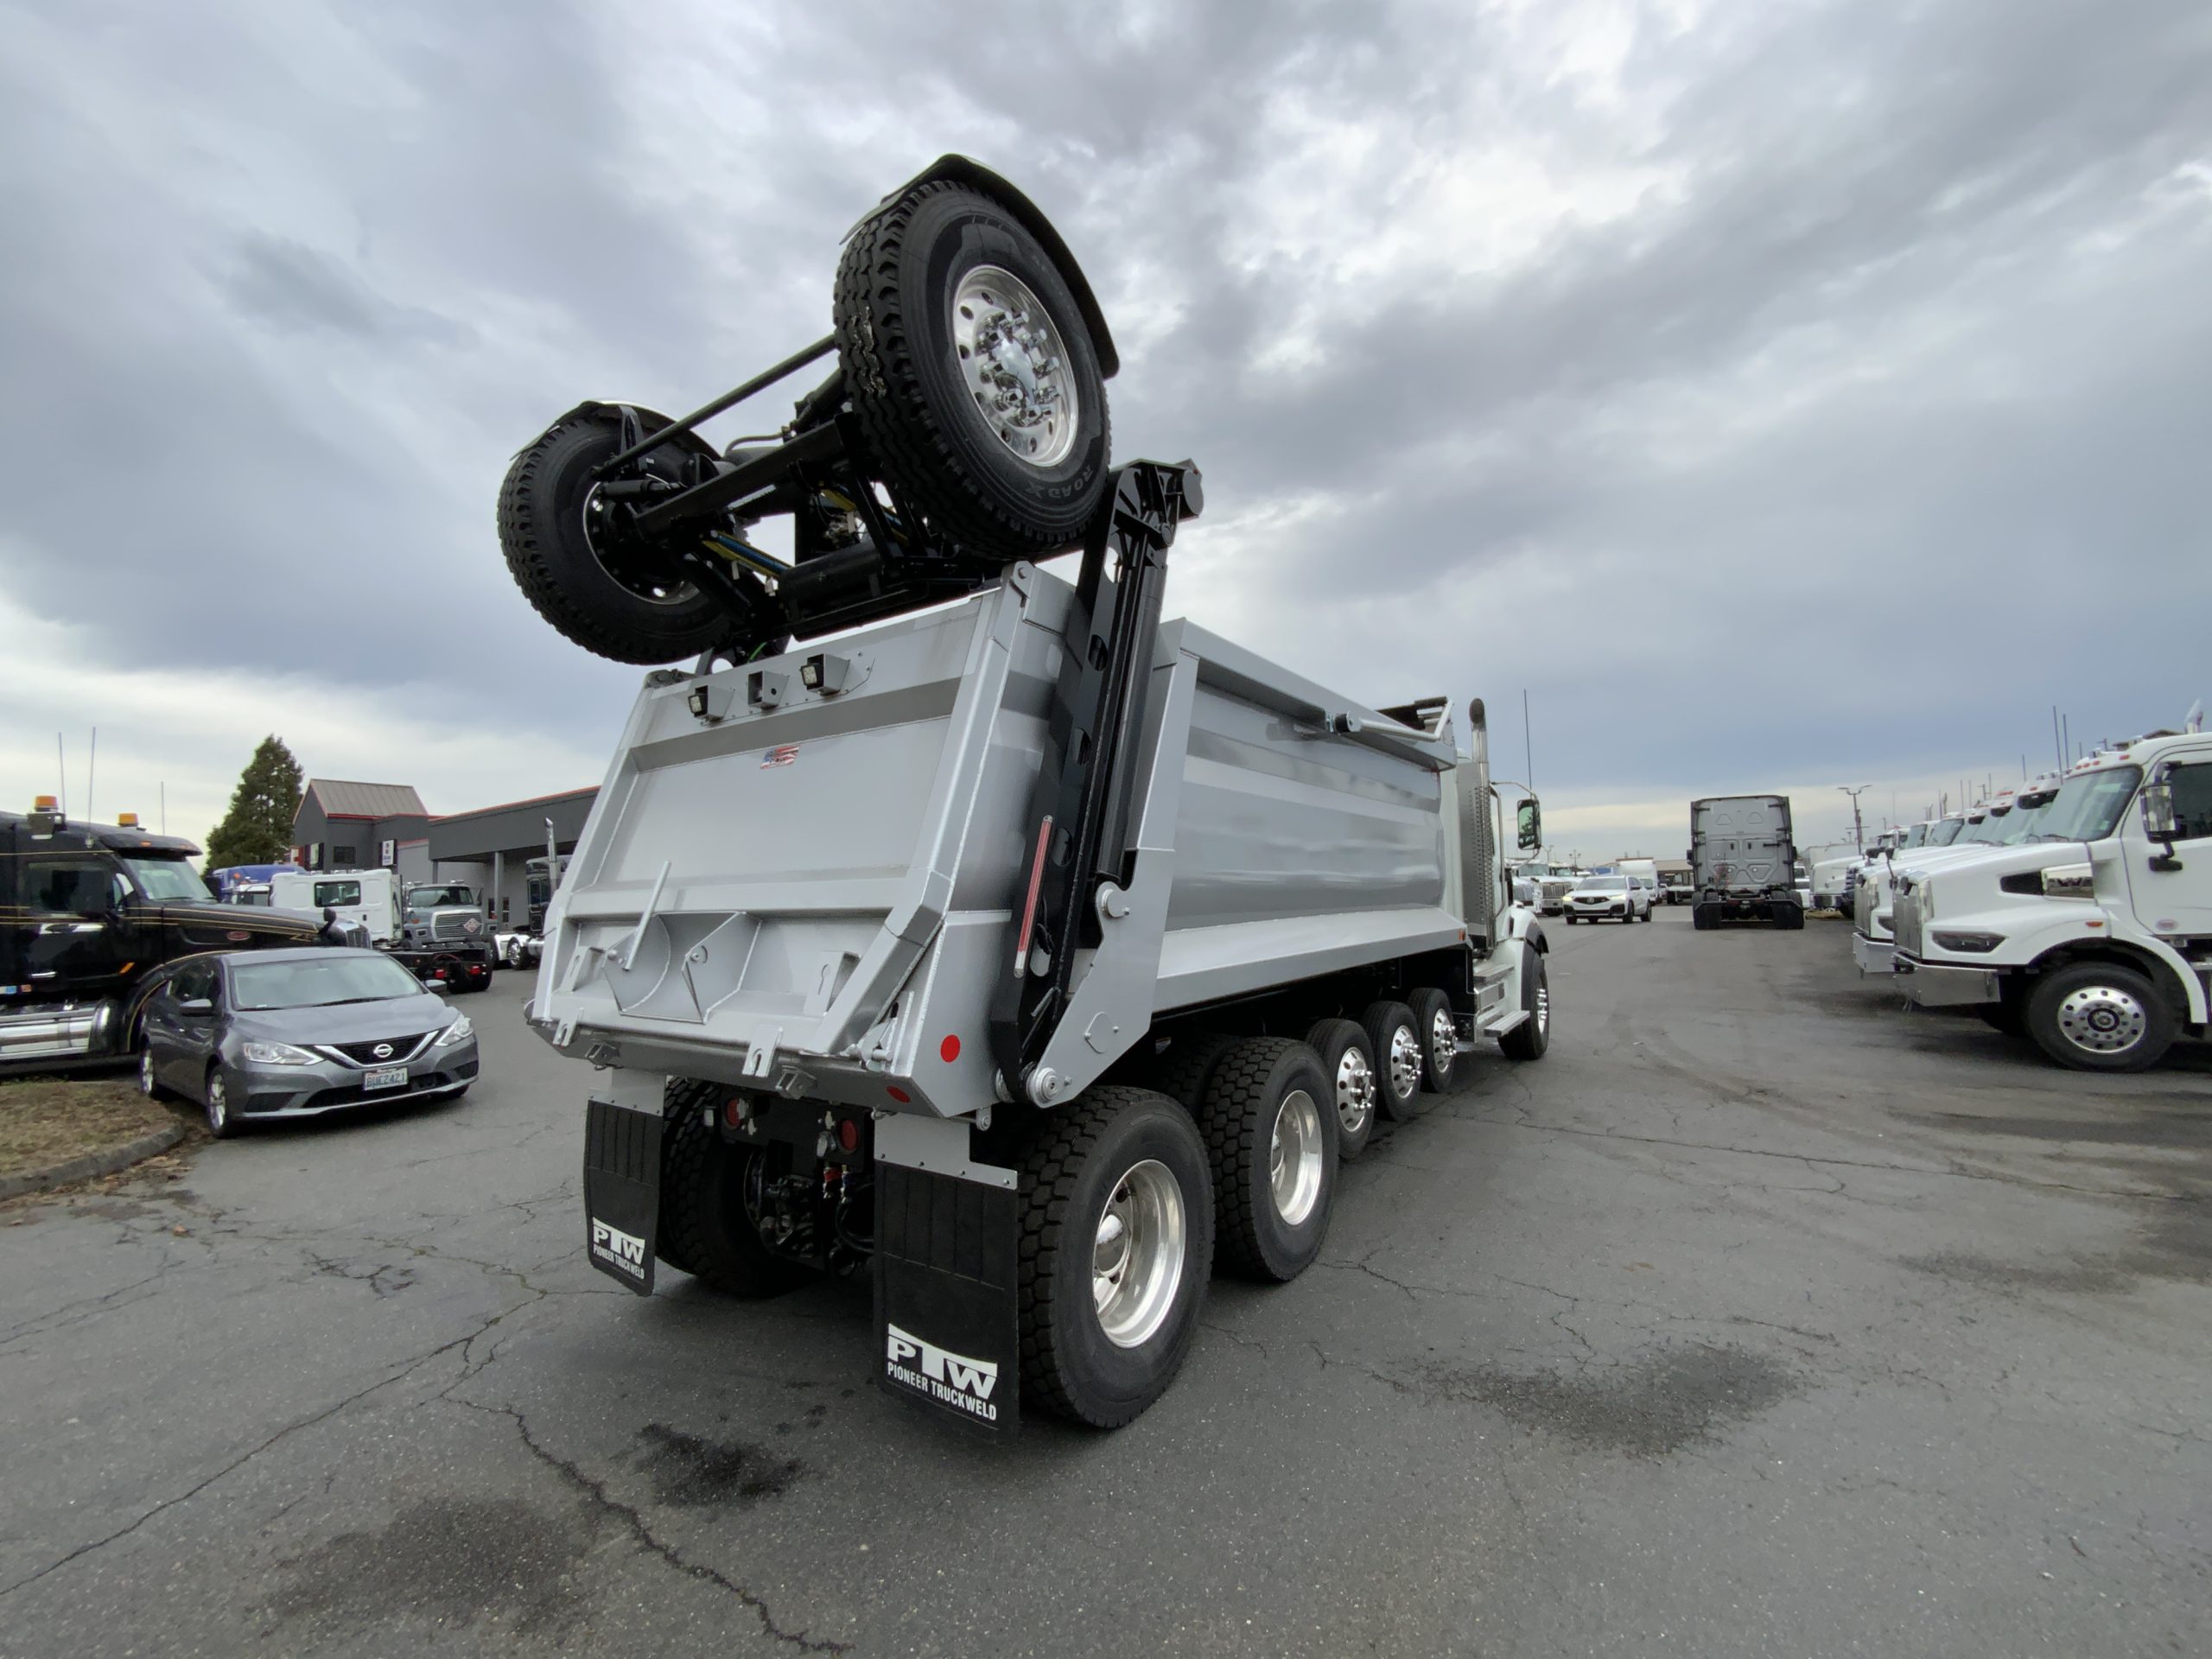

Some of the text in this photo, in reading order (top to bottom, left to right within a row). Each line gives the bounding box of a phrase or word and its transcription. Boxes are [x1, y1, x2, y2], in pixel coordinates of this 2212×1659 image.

[592, 1216, 646, 1266] PTW
[593, 1243, 645, 1280] PIONEER TRUCKWELD
[887, 1323, 998, 1400] PTW
[887, 1361, 997, 1421] PIONEER TRUCKWELD
